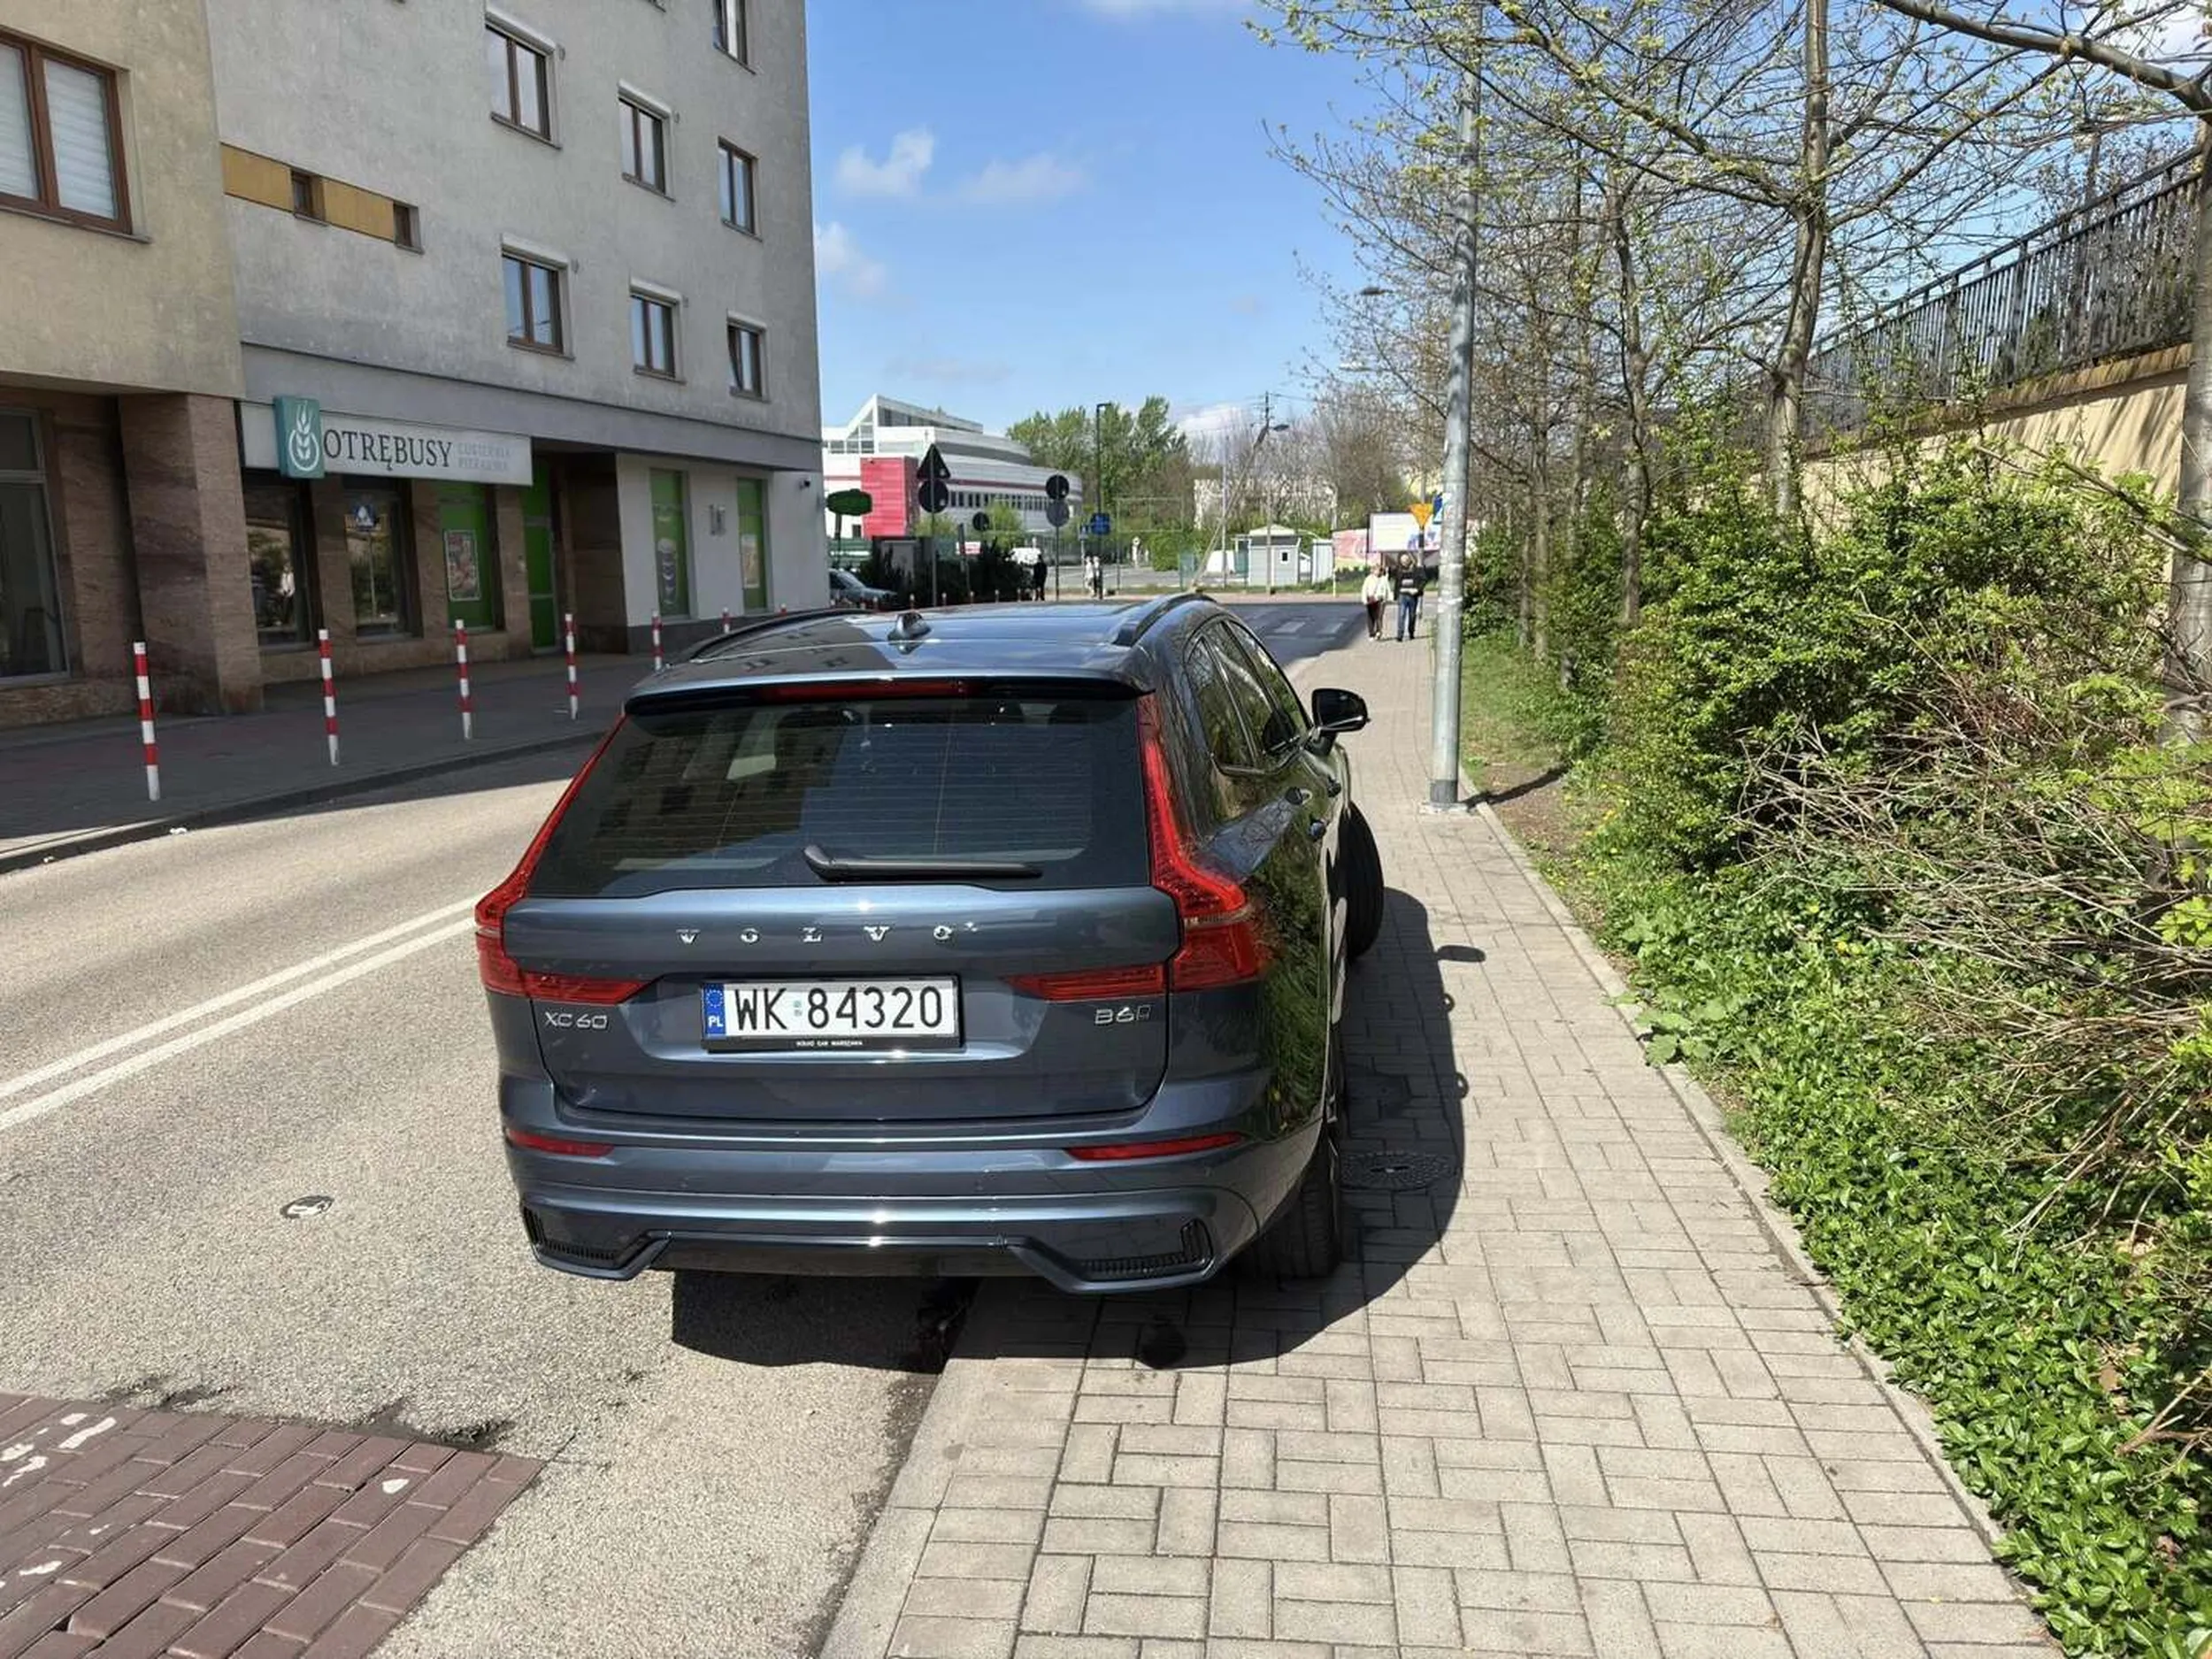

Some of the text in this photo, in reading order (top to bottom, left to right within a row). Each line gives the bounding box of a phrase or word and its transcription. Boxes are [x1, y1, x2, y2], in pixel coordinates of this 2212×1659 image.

[323, 429, 452, 472] OTRĘBUSY
[676, 926, 953, 944] VOLVO
[709, 1016, 724, 1028] PL
[735, 986, 943, 1030] WK 84320
